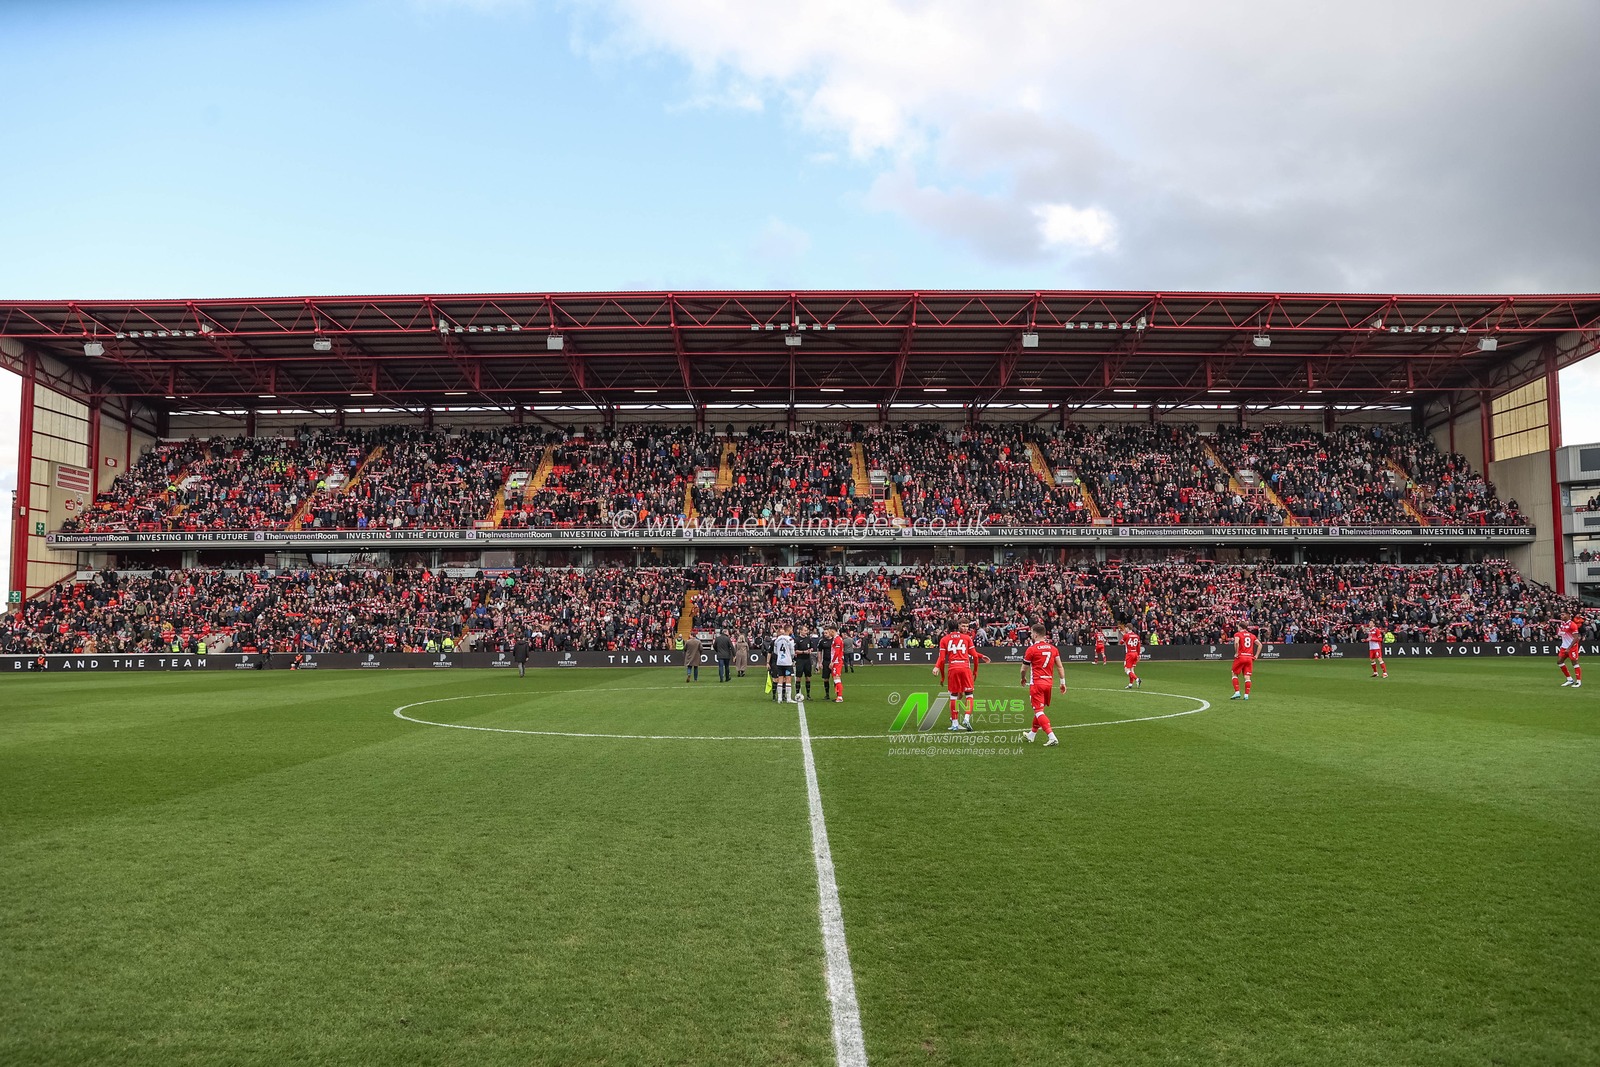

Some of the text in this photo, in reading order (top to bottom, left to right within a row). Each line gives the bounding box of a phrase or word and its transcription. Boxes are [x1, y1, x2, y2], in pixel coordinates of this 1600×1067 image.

[477, 530, 677, 539] TheInvestmentRoom INVESTING IN THE FUTURE
[914, 528, 1113, 536] TheInvestmentRoom INVESTING IN THE FUTURE
[57, 533, 249, 542] TheInvestmentRoom INVESTING IN THE FUTURE
[947, 639, 967, 654] 44
[1127, 637, 1139, 647] 48
[1244, 636, 1251, 648] 8
[779, 643, 786, 654] 4
[1384, 647, 1433, 655] HANK
[1446, 647, 1481, 655] YOU
[1495, 646, 1517, 654] TO
[608, 654, 672, 664] THANK
[877, 652, 911, 661] THE
[1041, 651, 1052, 668] 7
[63, 660, 99, 669] AND
[113, 660, 145, 668] THE
[159, 659, 207, 668] TEAM
